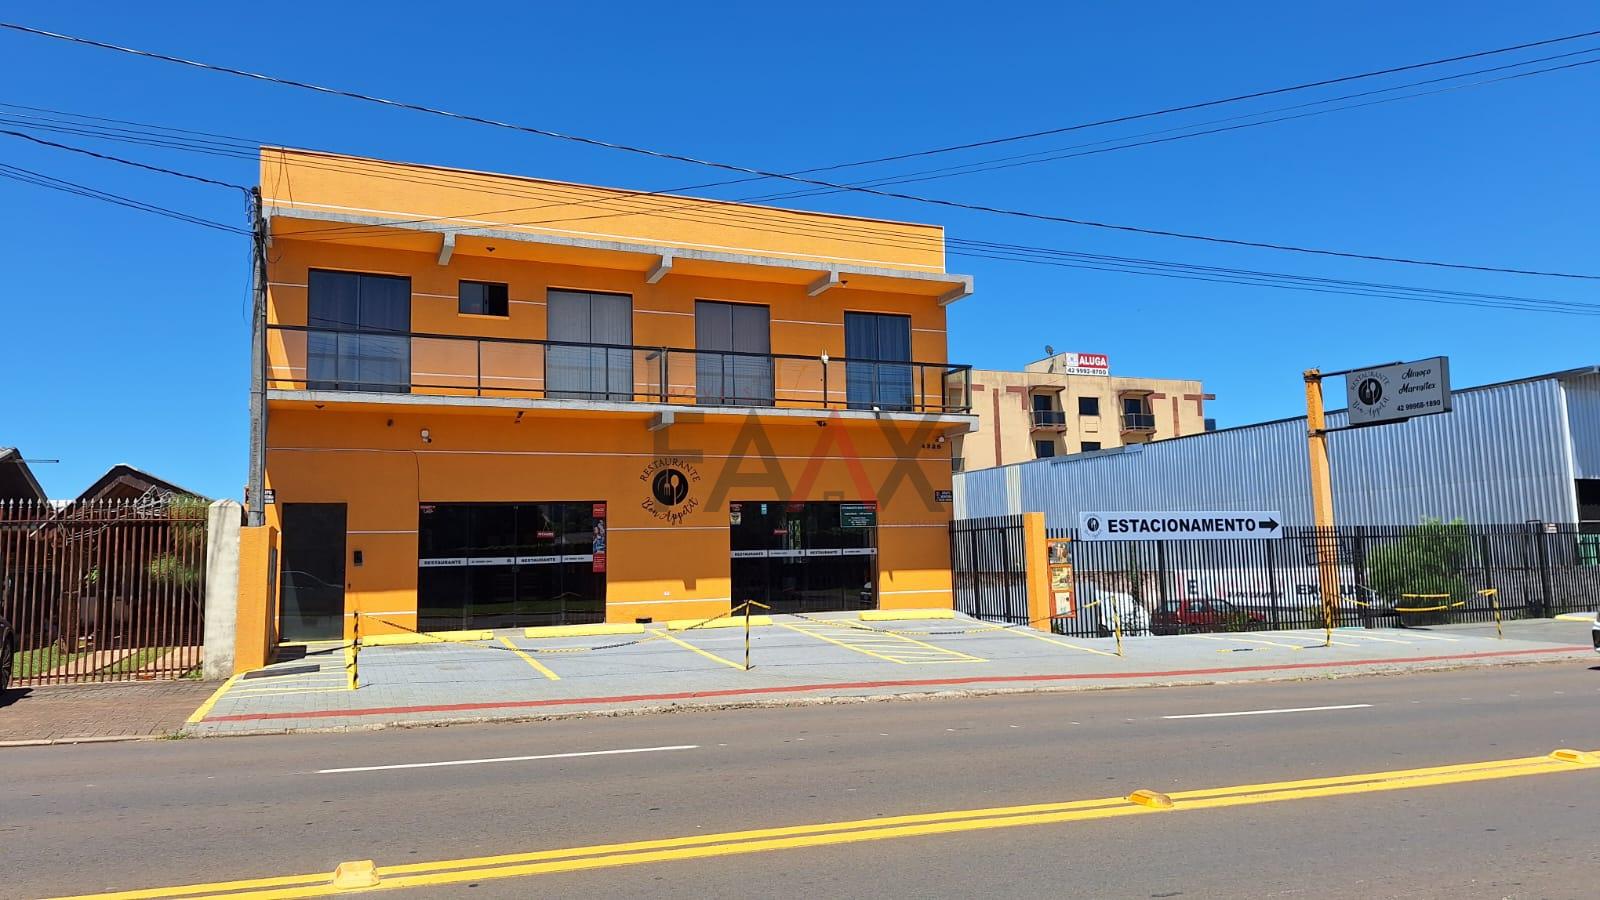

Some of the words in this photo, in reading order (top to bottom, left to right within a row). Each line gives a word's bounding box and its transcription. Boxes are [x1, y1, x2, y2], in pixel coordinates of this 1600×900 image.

[1080, 356, 1107, 366] ALUGA
[640, 457, 701, 482] RESTAURANTE
[641, 496, 660, 518] Bon
[1107, 518, 1256, 533] ESTACIONAMENTO
